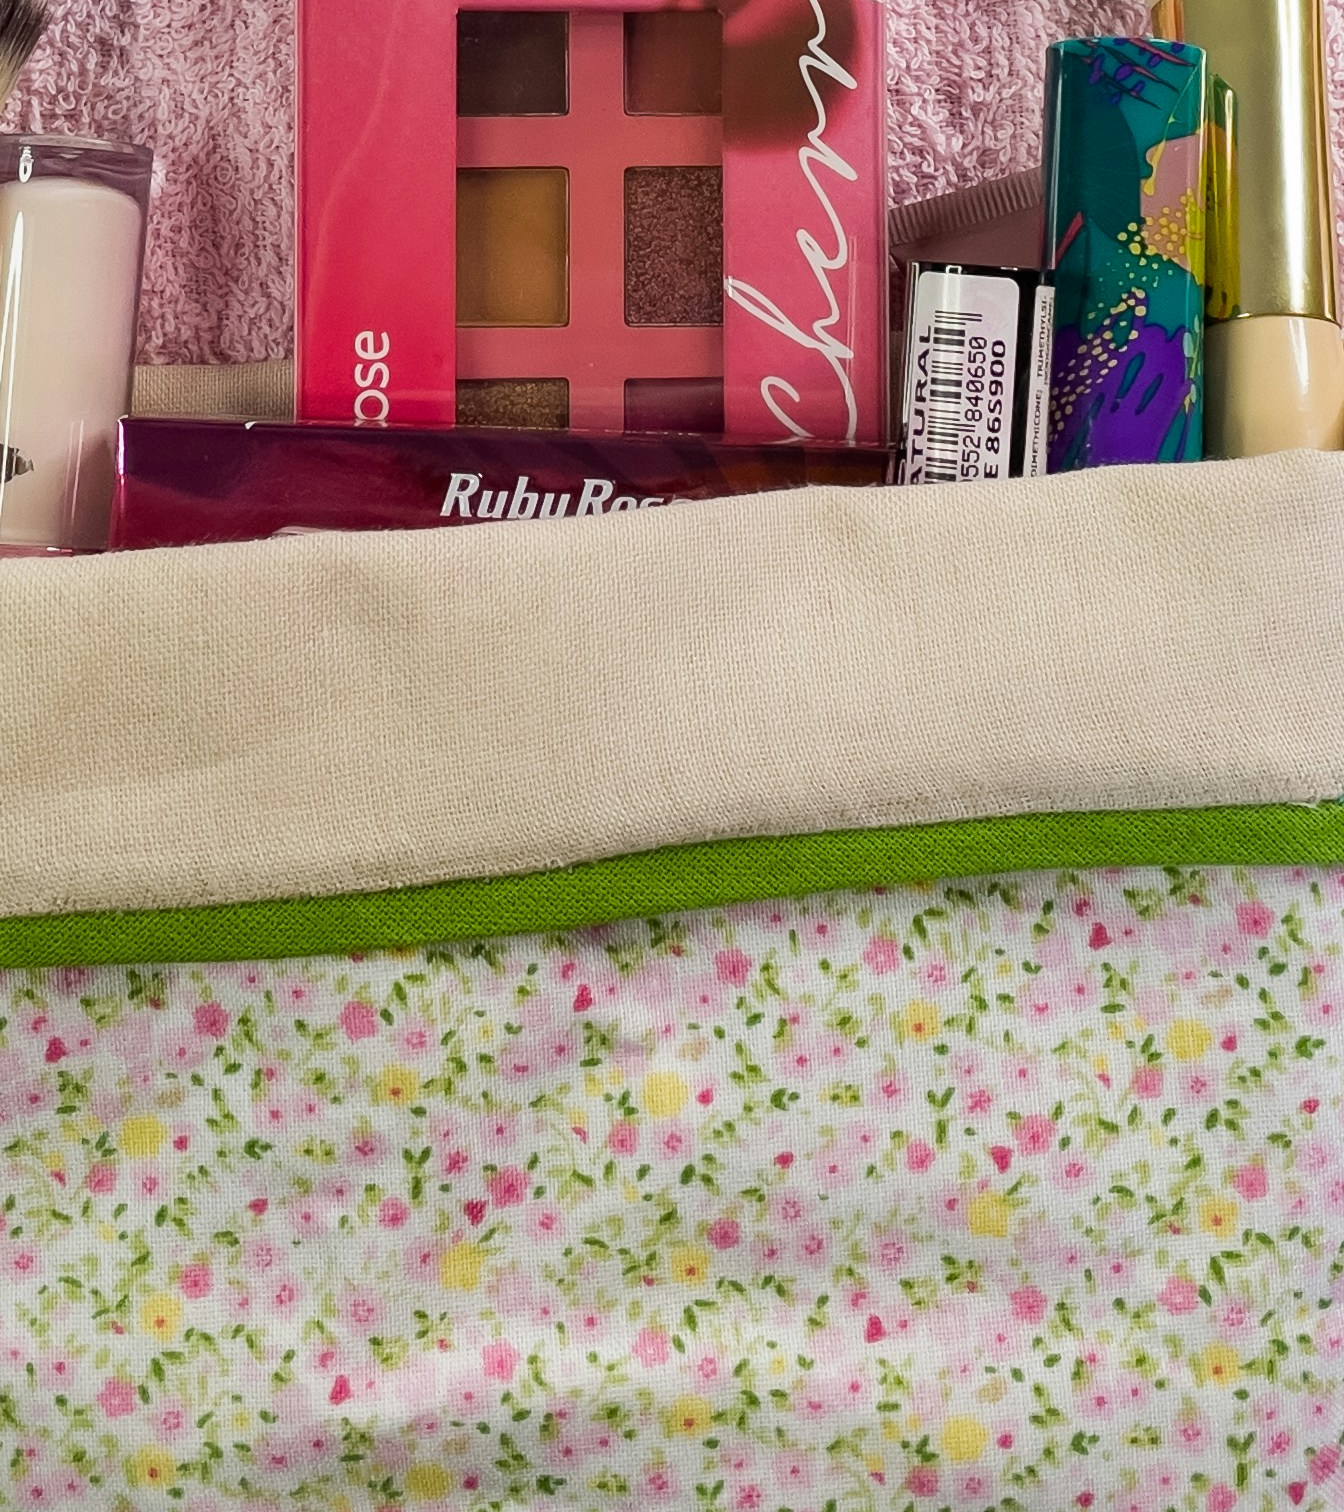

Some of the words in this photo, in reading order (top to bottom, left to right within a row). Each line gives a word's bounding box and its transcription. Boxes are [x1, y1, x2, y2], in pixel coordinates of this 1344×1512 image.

[354, 330, 390, 421] ose
[909, 325, 932, 484] ATURAL
[965, 336, 988, 423] 840650
